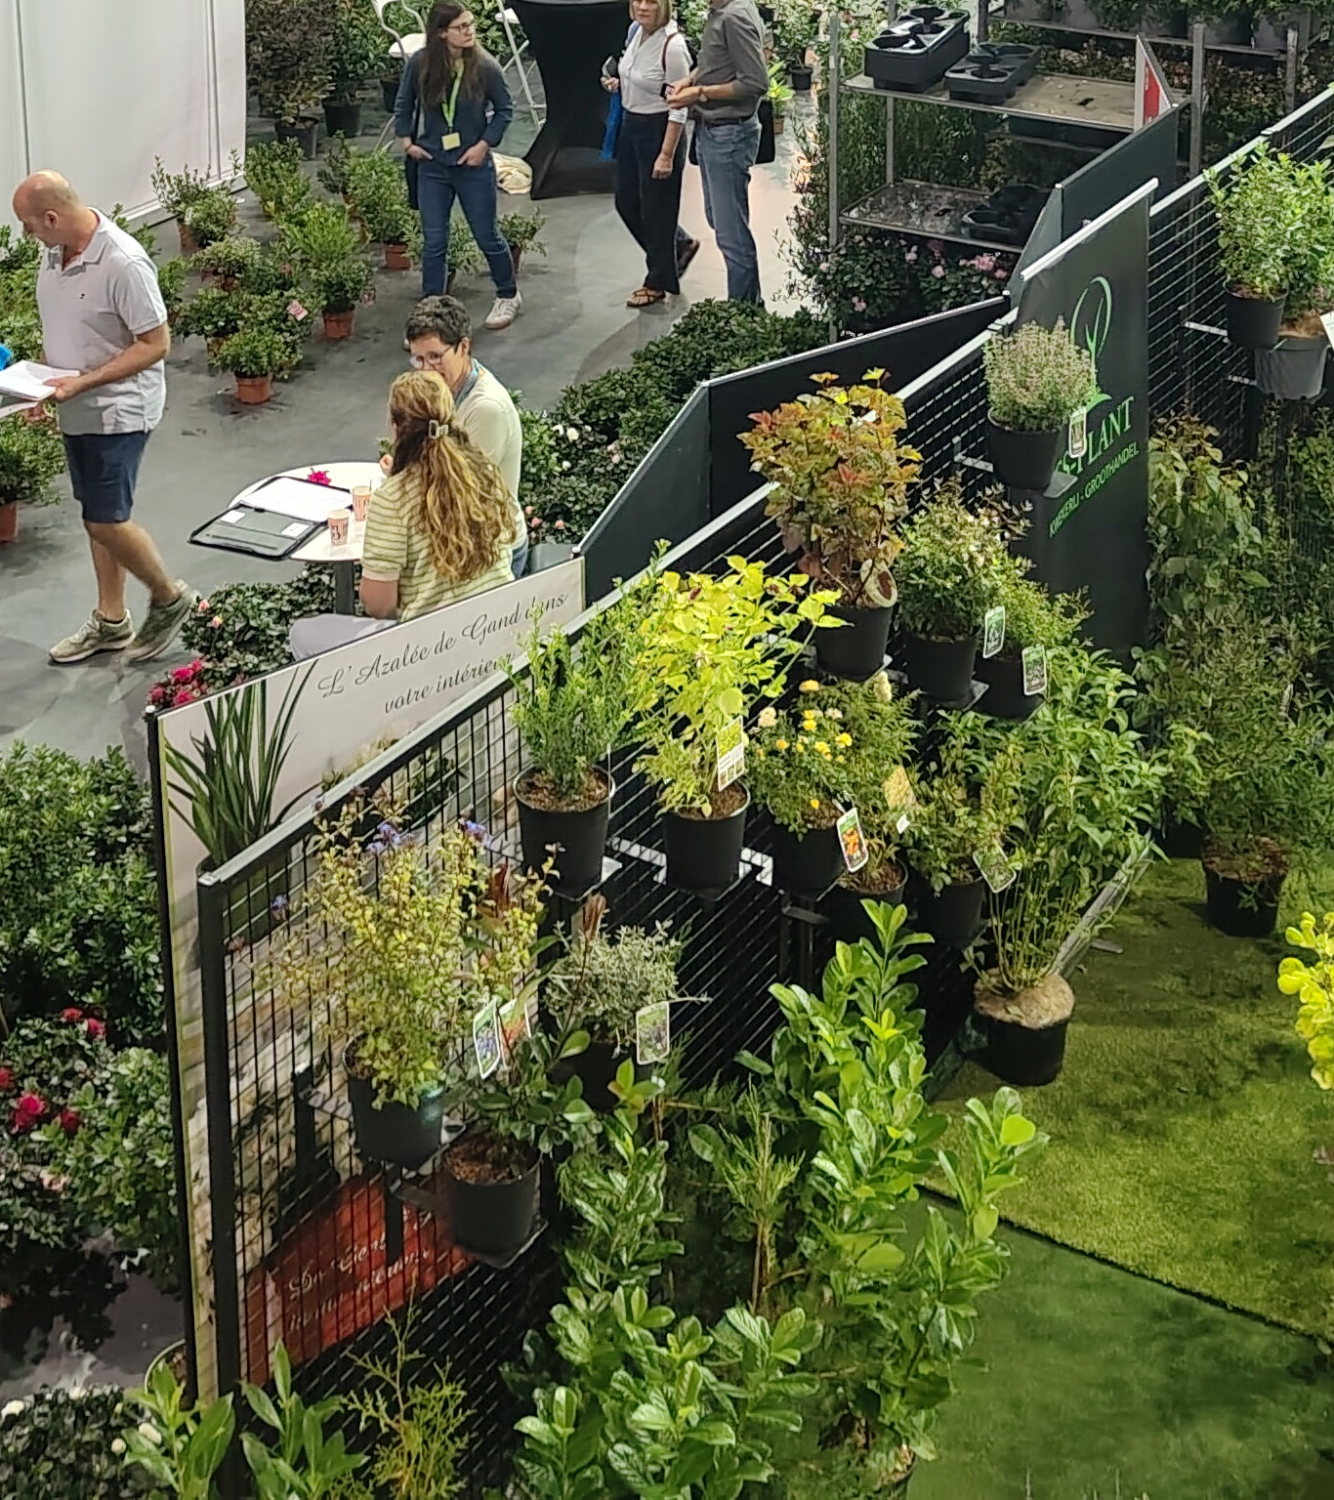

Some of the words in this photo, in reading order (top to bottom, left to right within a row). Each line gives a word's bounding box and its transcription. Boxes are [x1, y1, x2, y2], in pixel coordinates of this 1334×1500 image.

[1084, 441, 1140, 500] GROOTHANDEL
[434, 630, 458, 655] de
[461, 601, 526, 646] Gand
[385, 683, 435, 714] votre
